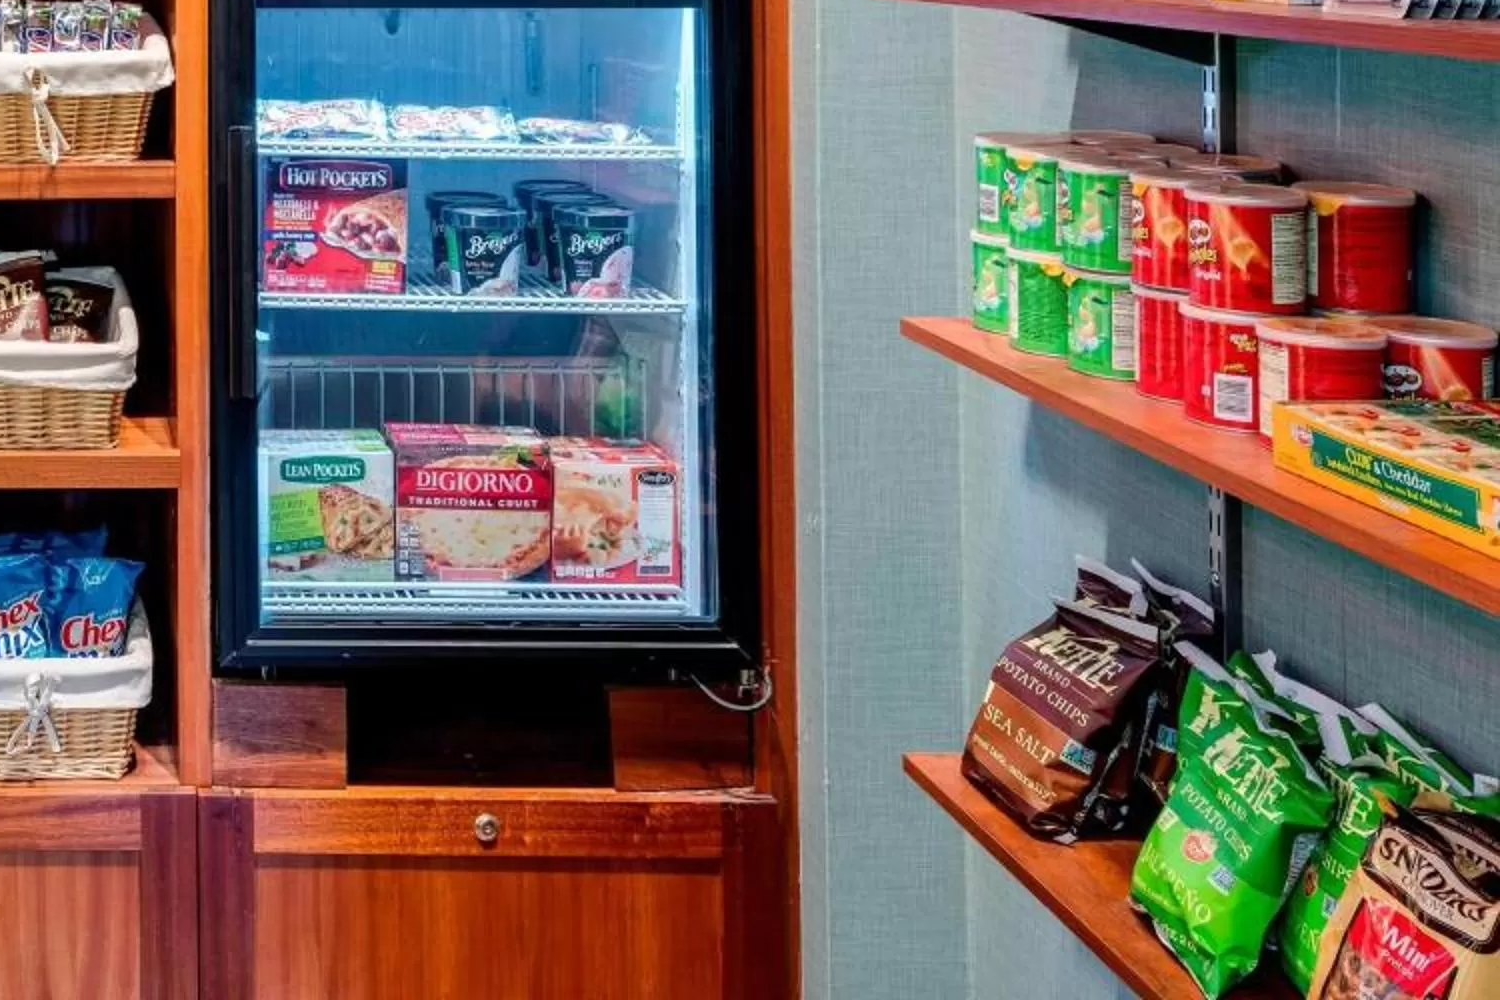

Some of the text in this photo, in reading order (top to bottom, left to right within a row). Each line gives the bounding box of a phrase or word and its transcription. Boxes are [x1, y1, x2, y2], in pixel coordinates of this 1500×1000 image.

[287, 167, 388, 187] HOT POCKETS
[465, 232, 520, 259] Breyers
[567, 231, 622, 256] Breyers
[407, 496, 538, 508] TRADITIONAL CRUST
[1032, 659, 1072, 689] BRAND
[996, 655, 1091, 728] POTATO CHIPS
[983, 702, 1057, 765] SEA SALT
[1179, 782, 1228, 832] POTATO
[1381, 920, 1433, 972] Mini
